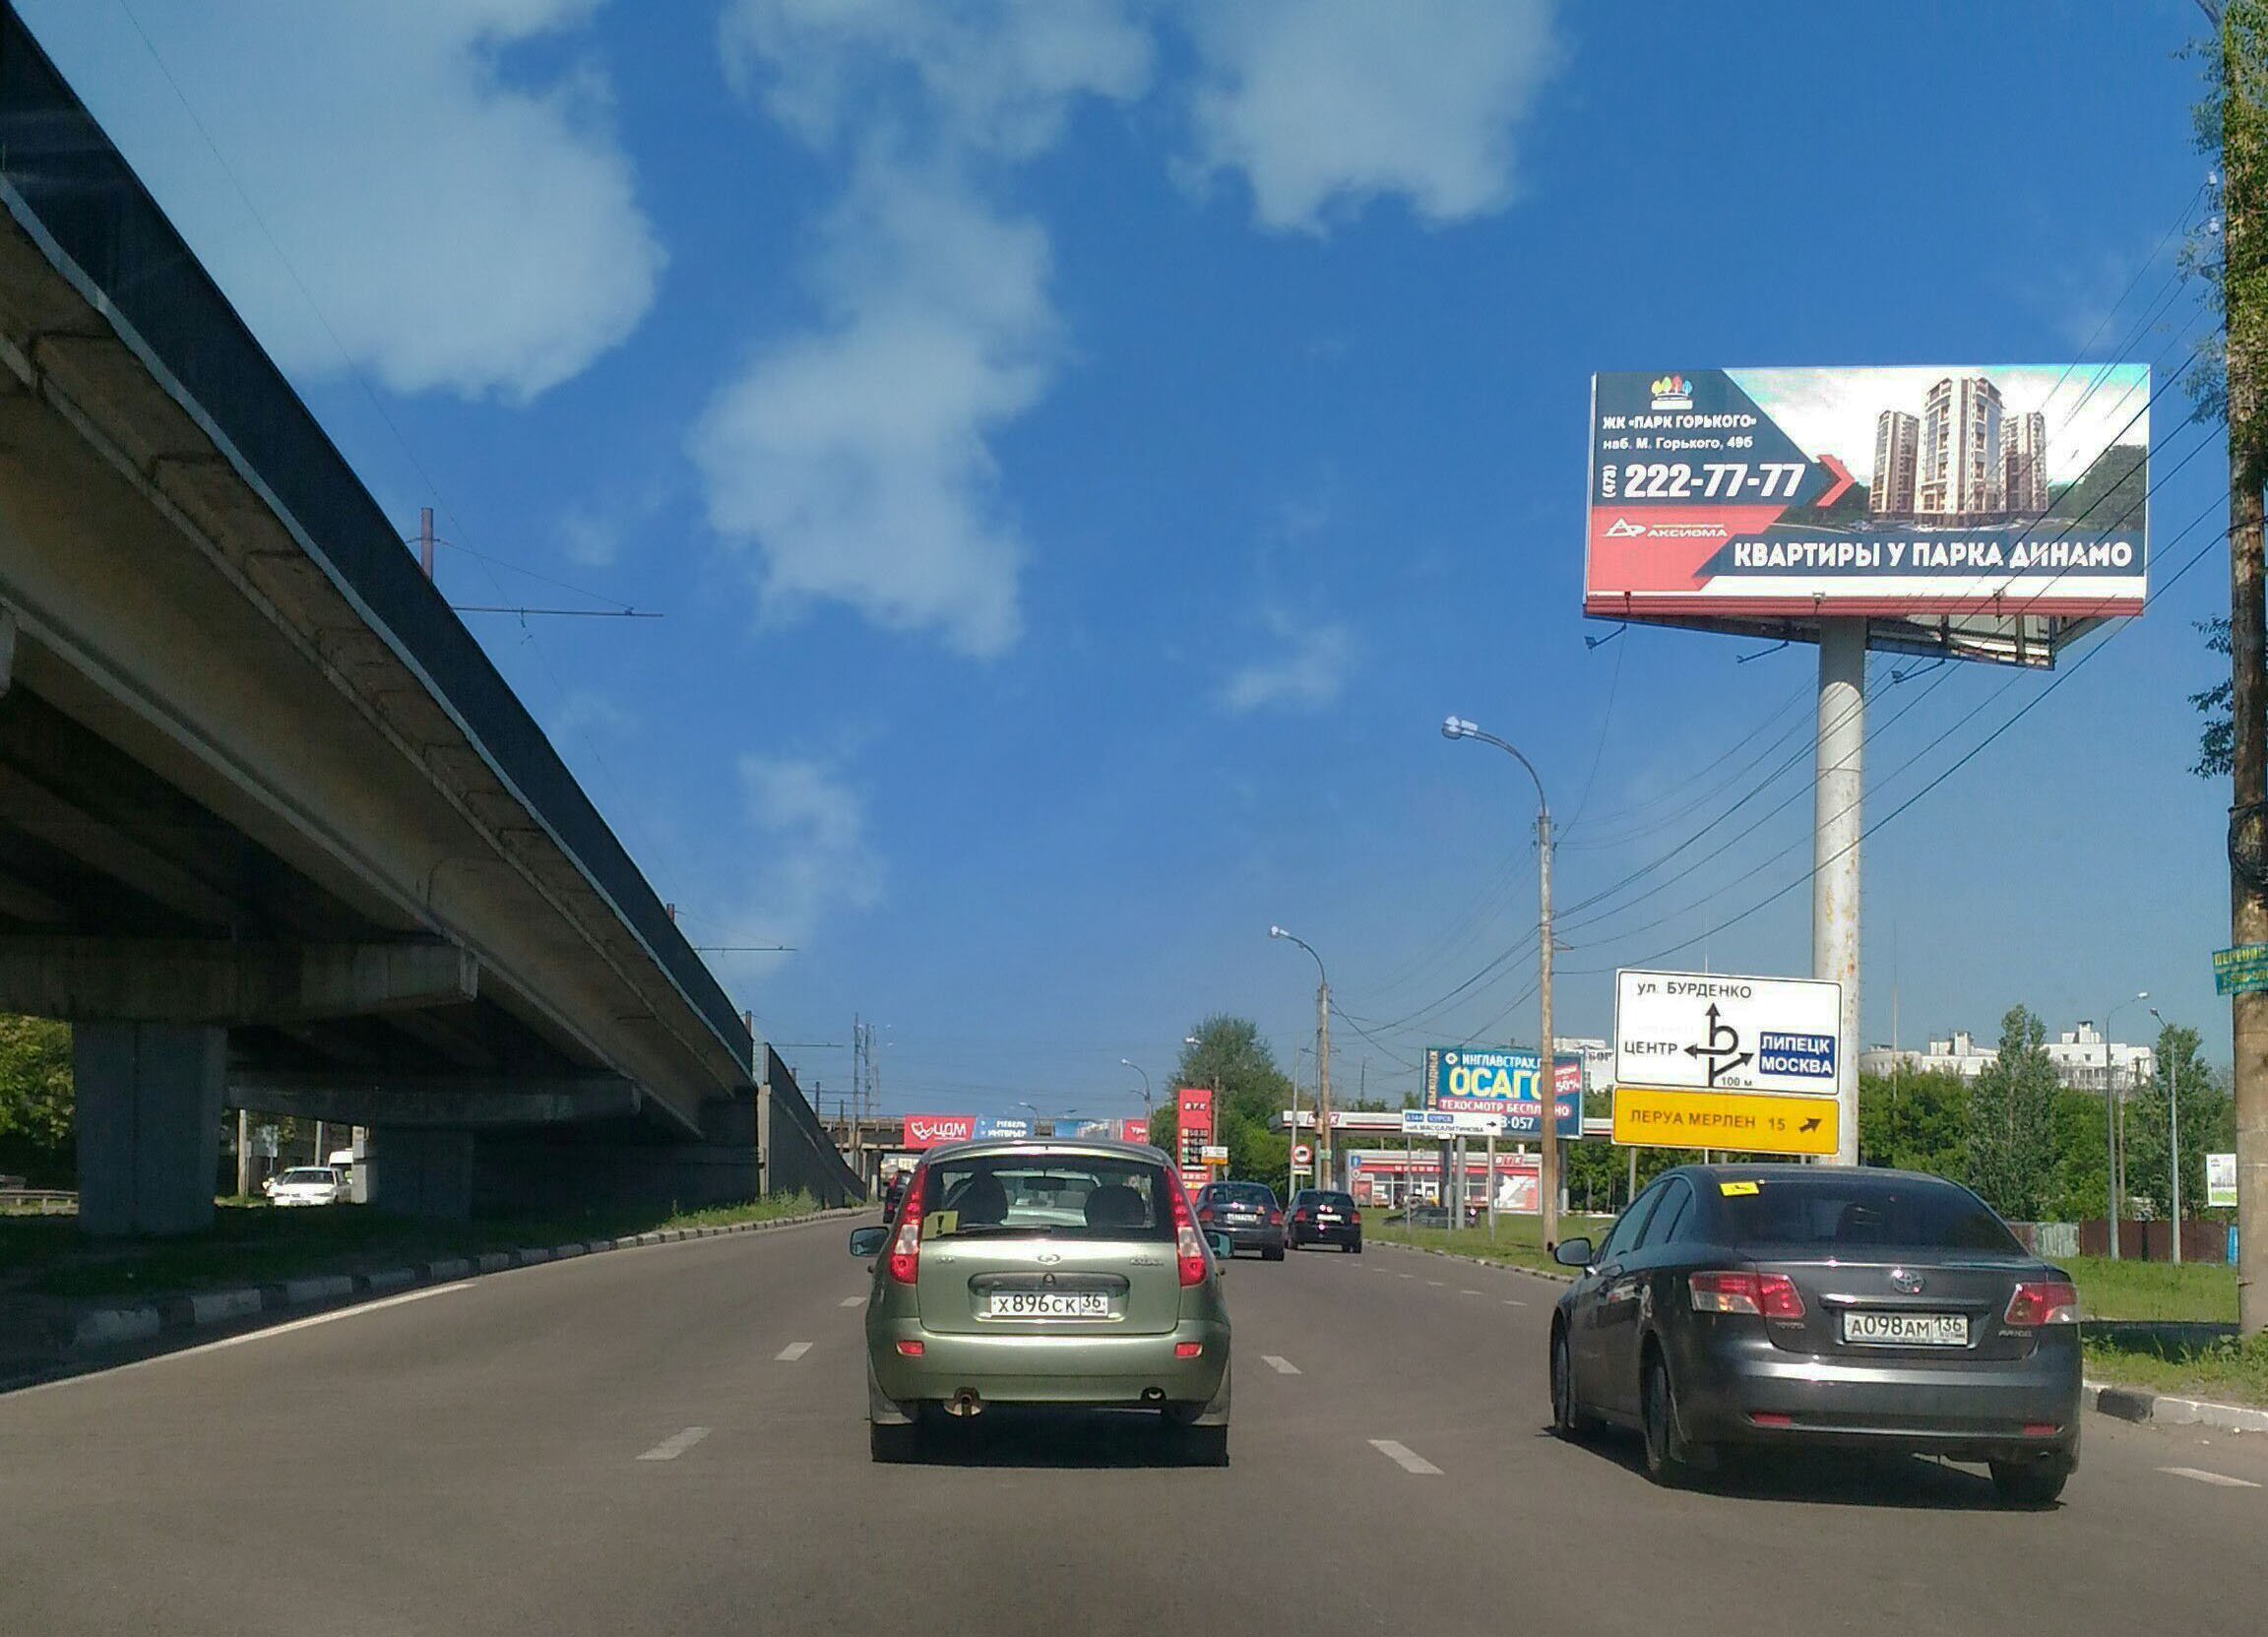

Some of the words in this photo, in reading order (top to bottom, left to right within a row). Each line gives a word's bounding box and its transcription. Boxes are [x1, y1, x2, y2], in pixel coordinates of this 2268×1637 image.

[1603, 416, 1626, 429] ЖК
[1603, 437, 1632, 450] наб.
[1635, 437, 1652, 449] М.
[1656, 437, 1724, 451] Горького,
[1624, 463, 1806, 498] 222-77-77
[1647, 528, 1729, 537] АКСИОМА
[1733, 542, 1880, 568] КВАРТИРЫ
[1889, 541, 1908, 567] У
[1913, 541, 2004, 568] ПАРКА
[2009, 540, 2133, 570] ДИНАМО
[1637, 983, 1659, 996] ул.
[1667, 981, 1752, 998] БУРДЕНКО
[1624, 1040, 1678, 1056] ЦЕНТР
[1761, 1036, 1830, 1054] ЛИПЕЦК
[1462, 1053, 1543, 1069] ИНГЛАВСТРАХ.
[1761, 1055, 1834, 1075] МОСКВА
[1721, 1076, 1740, 1087] 100
[1441, 1100, 1504, 1112] ТЕХОСМОТР
[1506, 1102, 1571, 1117] БЕСПЛНО
[1630, 1108, 1683, 1125] ЛЕРУА
[1688, 1111, 1756, 1128] МЕРЛЕН
[1768, 1117, 1787, 1130] 15
